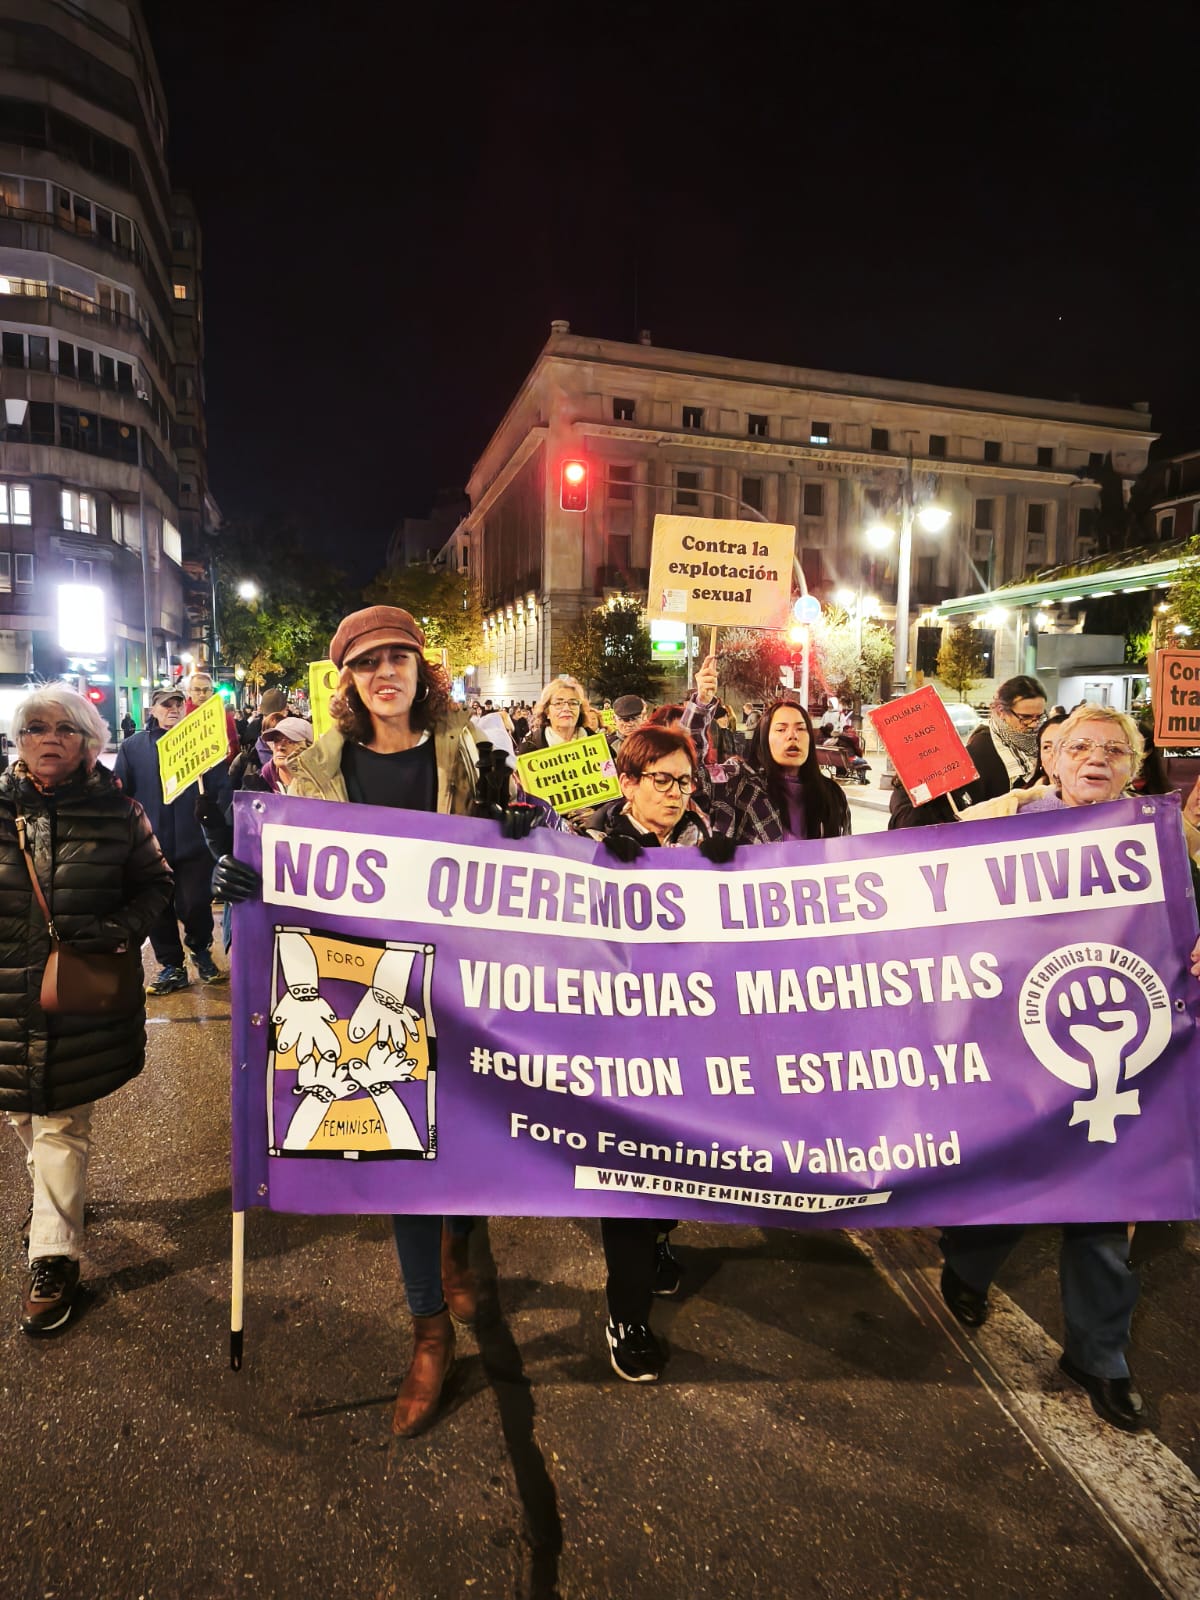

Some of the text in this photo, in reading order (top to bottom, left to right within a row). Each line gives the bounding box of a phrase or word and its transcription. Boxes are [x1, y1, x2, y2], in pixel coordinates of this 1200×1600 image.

[682, 535, 769, 556] Contra la
[669, 561, 778, 581] explotación
[692, 588, 752, 603] sexual
[165, 708, 214, 752] Contra la
[903, 733, 914, 744] 35
[168, 724, 216, 767] trata de
[527, 745, 598, 772] Contra la
[175, 741, 220, 783] niñas
[535, 760, 601, 788] trata de
[943, 761, 961, 773] 2022
[548, 779, 610, 806] niñas
[274, 839, 1152, 931] NOS QUEREMOS LIBRES Y VIVAS
[327, 949, 365, 967] FORO
[458, 951, 1003, 1017] VIOLENCIAS MACHISTAS
[1024, 947, 1167, 1025] Foro Feminista Valladolid
[469, 1046, 684, 1097] #CUESTION
[705, 1056, 755, 1095] DE
[323, 1115, 382, 1136] FEMINISTA
[510, 1112, 961, 1173] Foro Feminista Valladolid
[597, 1170, 868, 1209] WWW.FOROFEMINISTACYL.ORG
